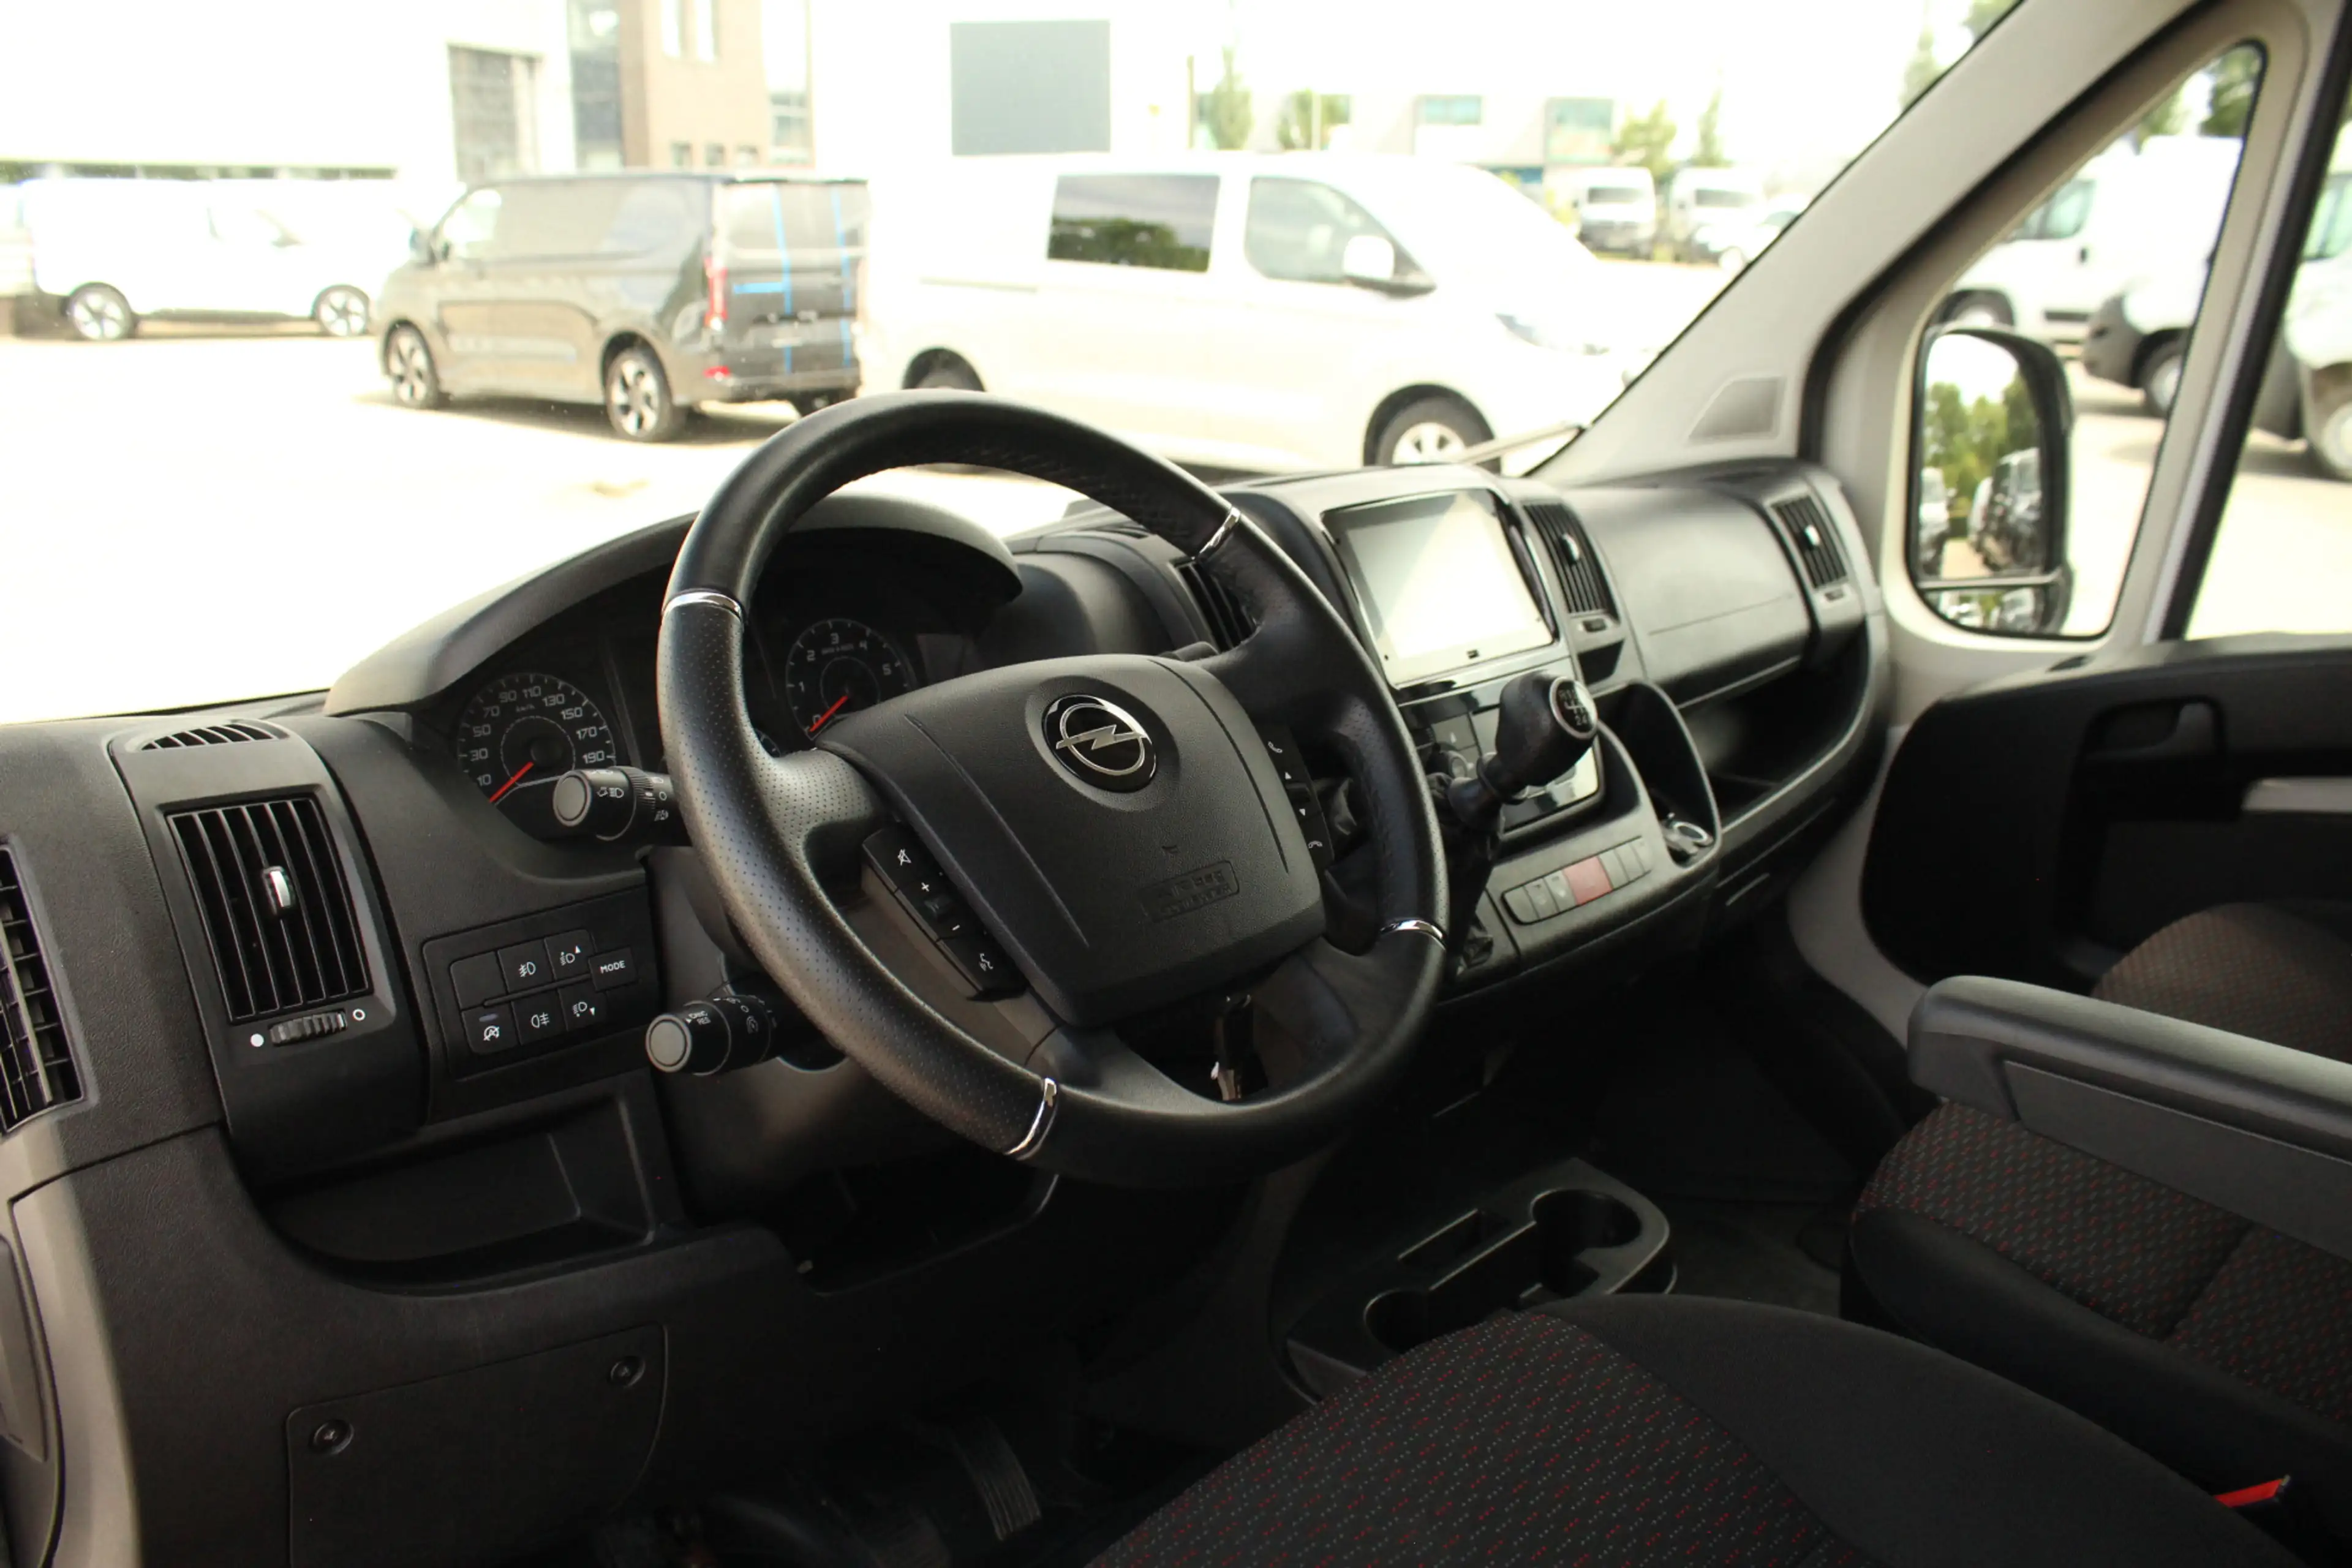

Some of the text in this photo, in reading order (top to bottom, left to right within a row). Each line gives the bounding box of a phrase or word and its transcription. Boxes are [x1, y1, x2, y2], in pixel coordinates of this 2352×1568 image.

[831, 633, 839, 643] 3
[859, 640, 867, 650] 4
[807, 650, 815, 662] 2
[883, 664, 891, 675] 5
[523, 687, 541, 698] 110
[799, 681, 805, 692] 1
[499, 691, 517, 703] 90
[542, 693, 565, 707] 130
[483, 706, 500, 718] 70
[560, 707, 582, 720] 150
[473, 724, 491, 737] 50
[576, 726, 597, 740] 170
[470, 748, 488, 761] 30
[582, 750, 605, 764] 190
[477, 774, 491, 786] 10
[600, 960, 625, 974] MODE
